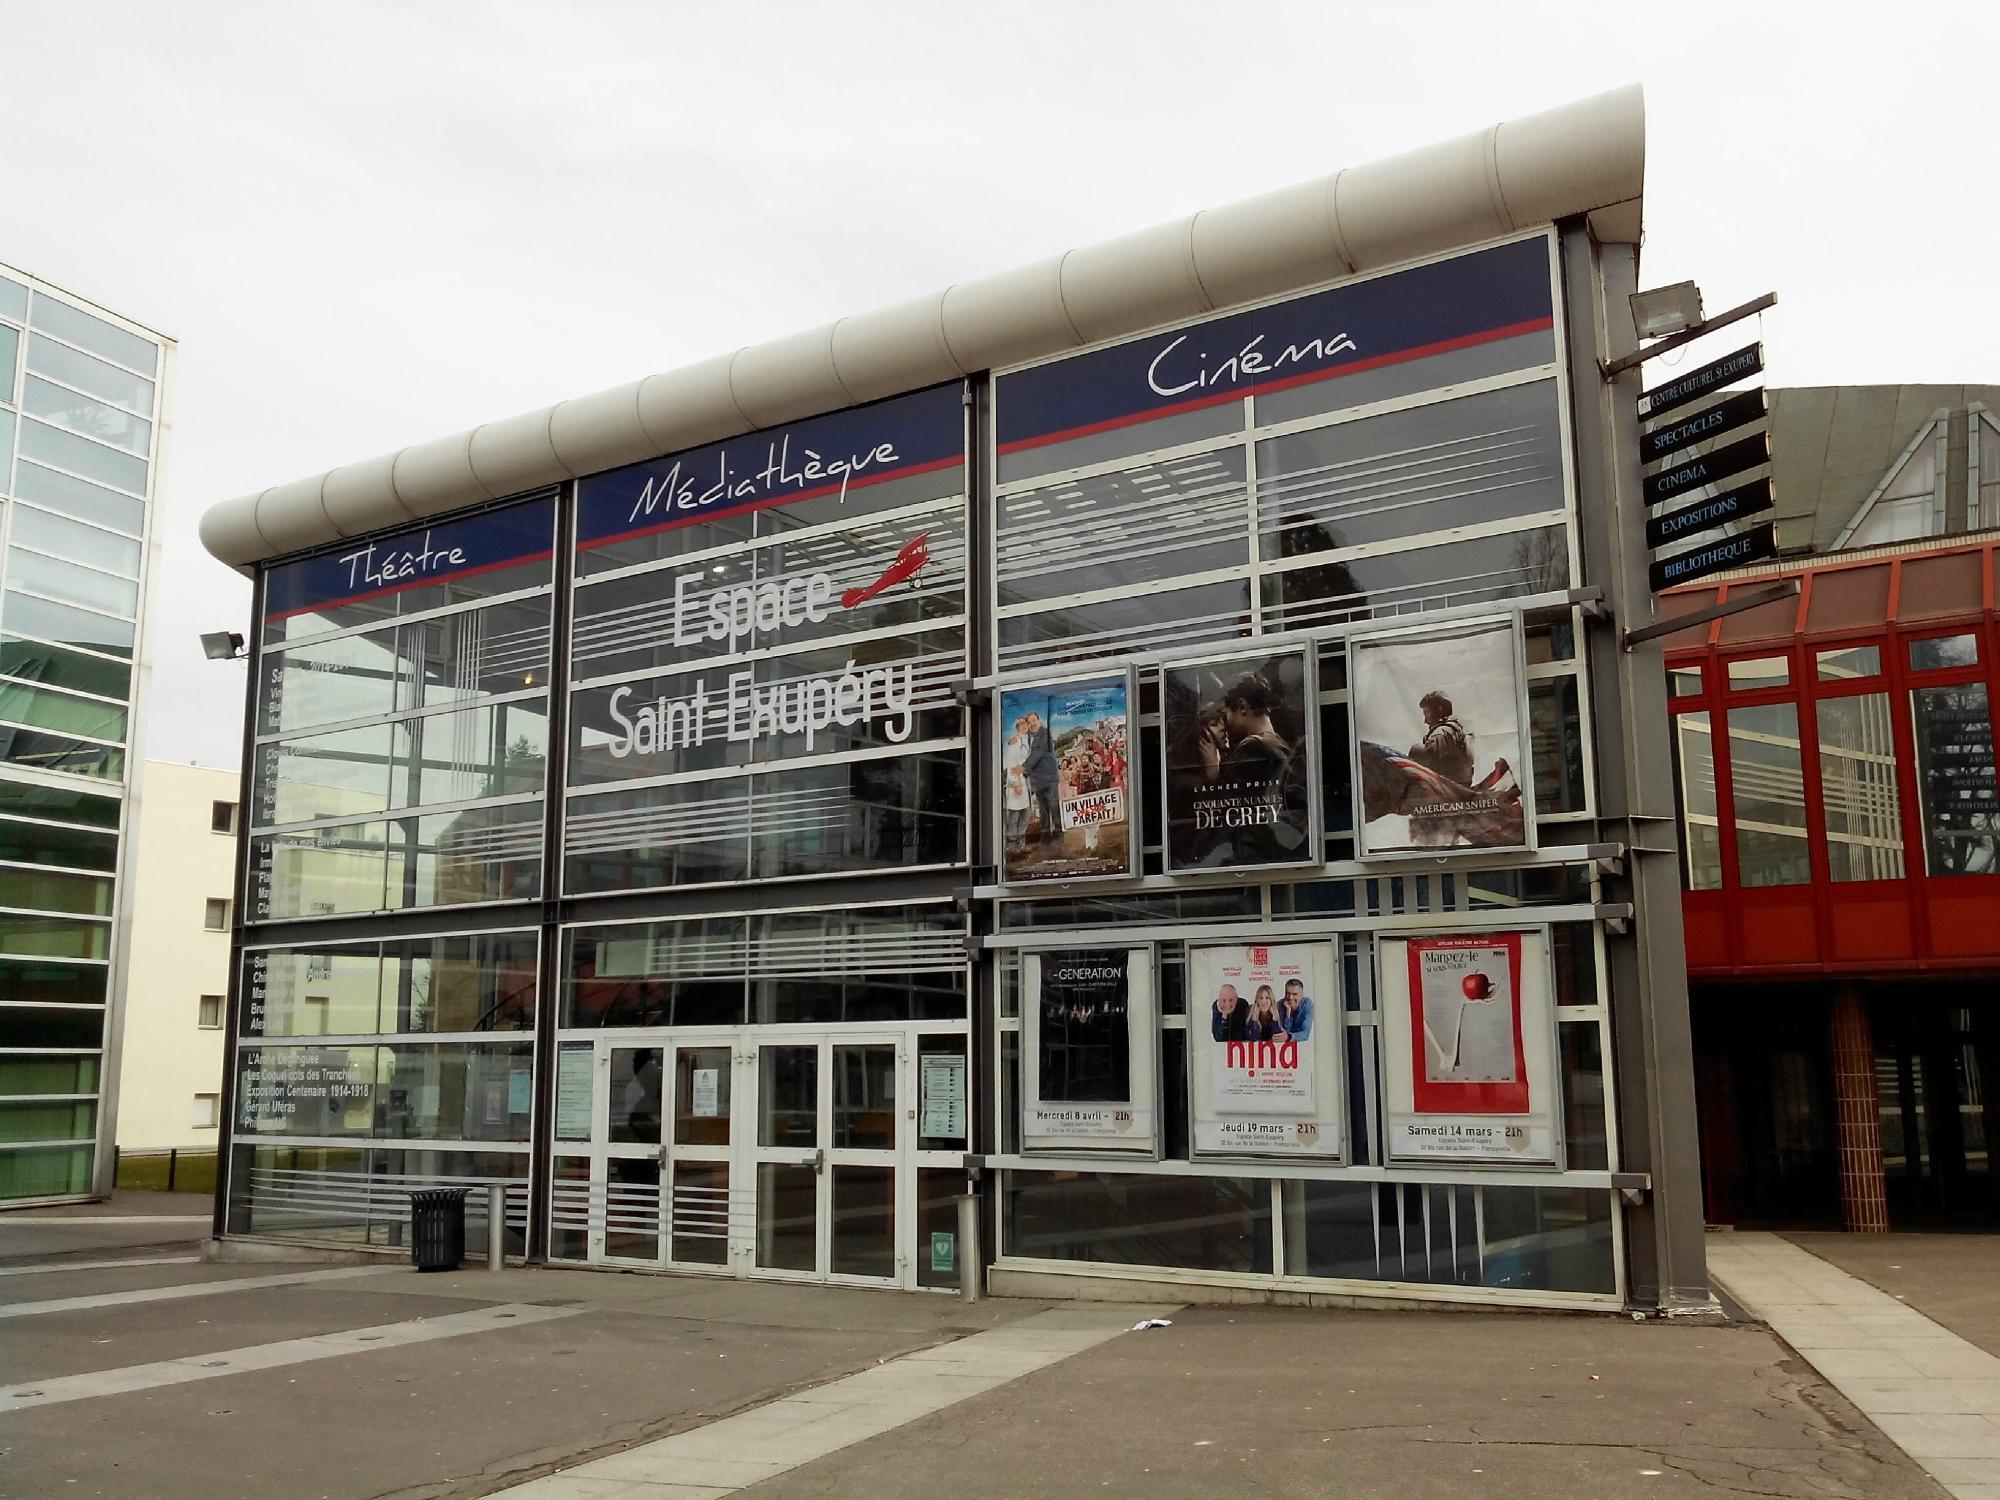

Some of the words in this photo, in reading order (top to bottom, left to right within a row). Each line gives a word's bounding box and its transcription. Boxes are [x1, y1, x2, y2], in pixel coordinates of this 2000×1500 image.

[1147, 332, 1357, 396] Cinéma
[1651, 385, 1679, 407] CENTRE
[1680, 370, 1715, 396] CULTUREL
[1723, 351, 1757, 376] EXUPERY
[1654, 411, 1723, 449] SPECTACLES
[628, 434, 900, 523] Médiathèque
[1657, 463, 1707, 491] CINEMA
[1661, 497, 1738, 535] EXPOSITIONS
[339, 530, 467, 588] Théâtre
[1664, 538, 1751, 578] BIBLIOTHEQUE
[673, 570, 832, 655] Espace
[608, 659, 913, 759] Saint-Exupéry
[1246, 779, 1280, 788] PRISE
[1065, 801, 1078, 813] UN
[1079, 793, 1117, 809] VILLAGE
[1193, 797, 1242, 810] CINQUANTE
[1413, 802, 1463, 815] AMERICAN
[1465, 798, 1499, 810] SNIPER
[1194, 809, 1223, 830] DE
[1225, 803, 1283, 827] GREY
[1425, 950, 1479, 964] Mangez-le
[1047, 967, 1121, 980] -GENERATION
[247, 1069, 260, 1080] Les
[306, 1069, 320, 1080] des
[247, 1084, 285, 1098] Exposition
[286, 1084, 327, 1097] Centenaire
[330, 1084, 369, 1097] 1914-1918
[245, 1100, 270, 1112] Gérard
[1036, 1111, 1073, 1120] Mercredi
[1074, 1111, 1080, 1120] 8
[1082, 1111, 1102, 1120] avril
[1115, 1111, 1130, 1121] 21h
[1220, 1123, 1245, 1132] Jeudi
[1247, 1123, 1257, 1132] 19
[1259, 1125, 1284, 1133] mars
[1297, 1124, 1316, 1134] 21h
[1407, 1125, 1447, 1136] Samedi
[1451, 1126, 1461, 1136] 14
[1465, 1127, 1492, 1137] mars
[1505, 1126, 1523, 1137] 21h
